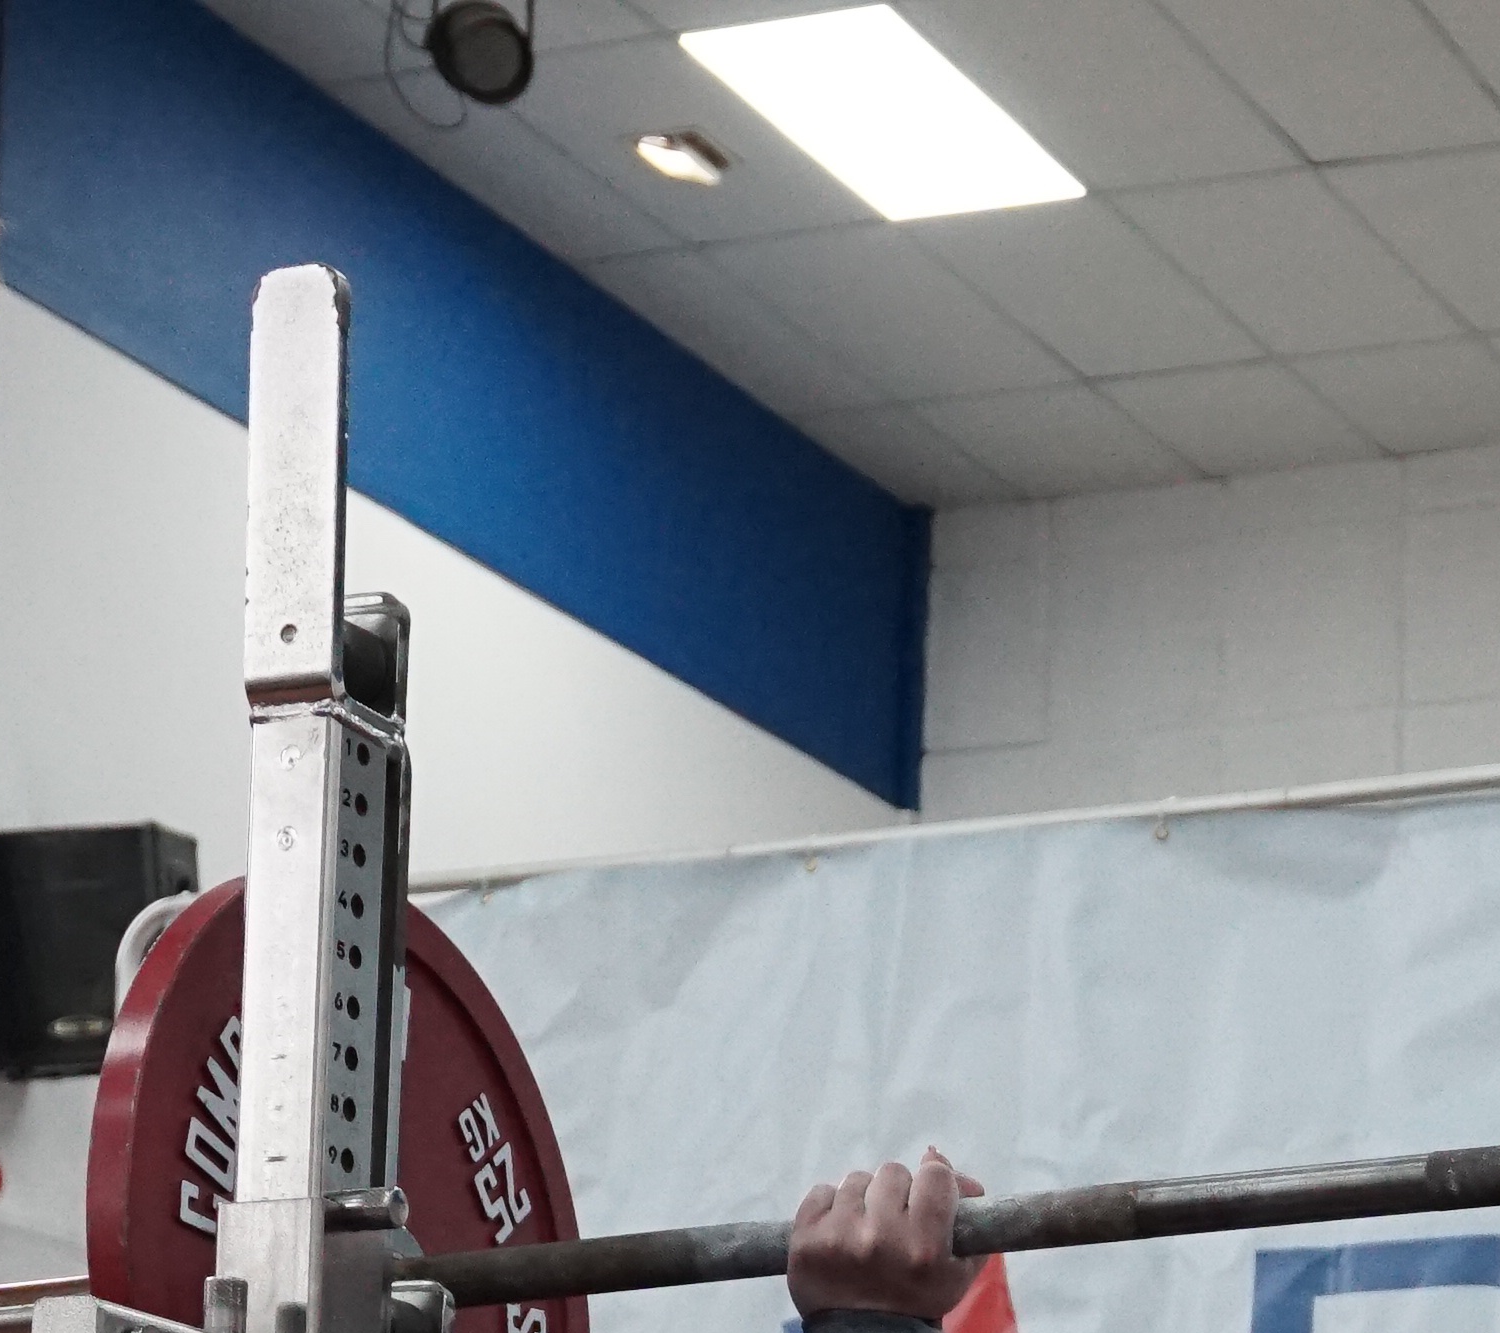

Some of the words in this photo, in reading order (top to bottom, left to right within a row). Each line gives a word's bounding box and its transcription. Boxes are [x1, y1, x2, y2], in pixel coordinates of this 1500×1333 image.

[343, 788, 351, 808] 2
[340, 838, 349, 856] 3
[338, 890, 348, 909] 4
[336, 940, 345, 959] 5
[334, 992, 343, 1011] 6
[332, 1042, 341, 1062] 7
[330, 1095, 339, 1113] 8
[458, 1092, 500, 1163] KG
[328, 1145, 337, 1165] 9
[474, 1141, 531, 1244] 25
